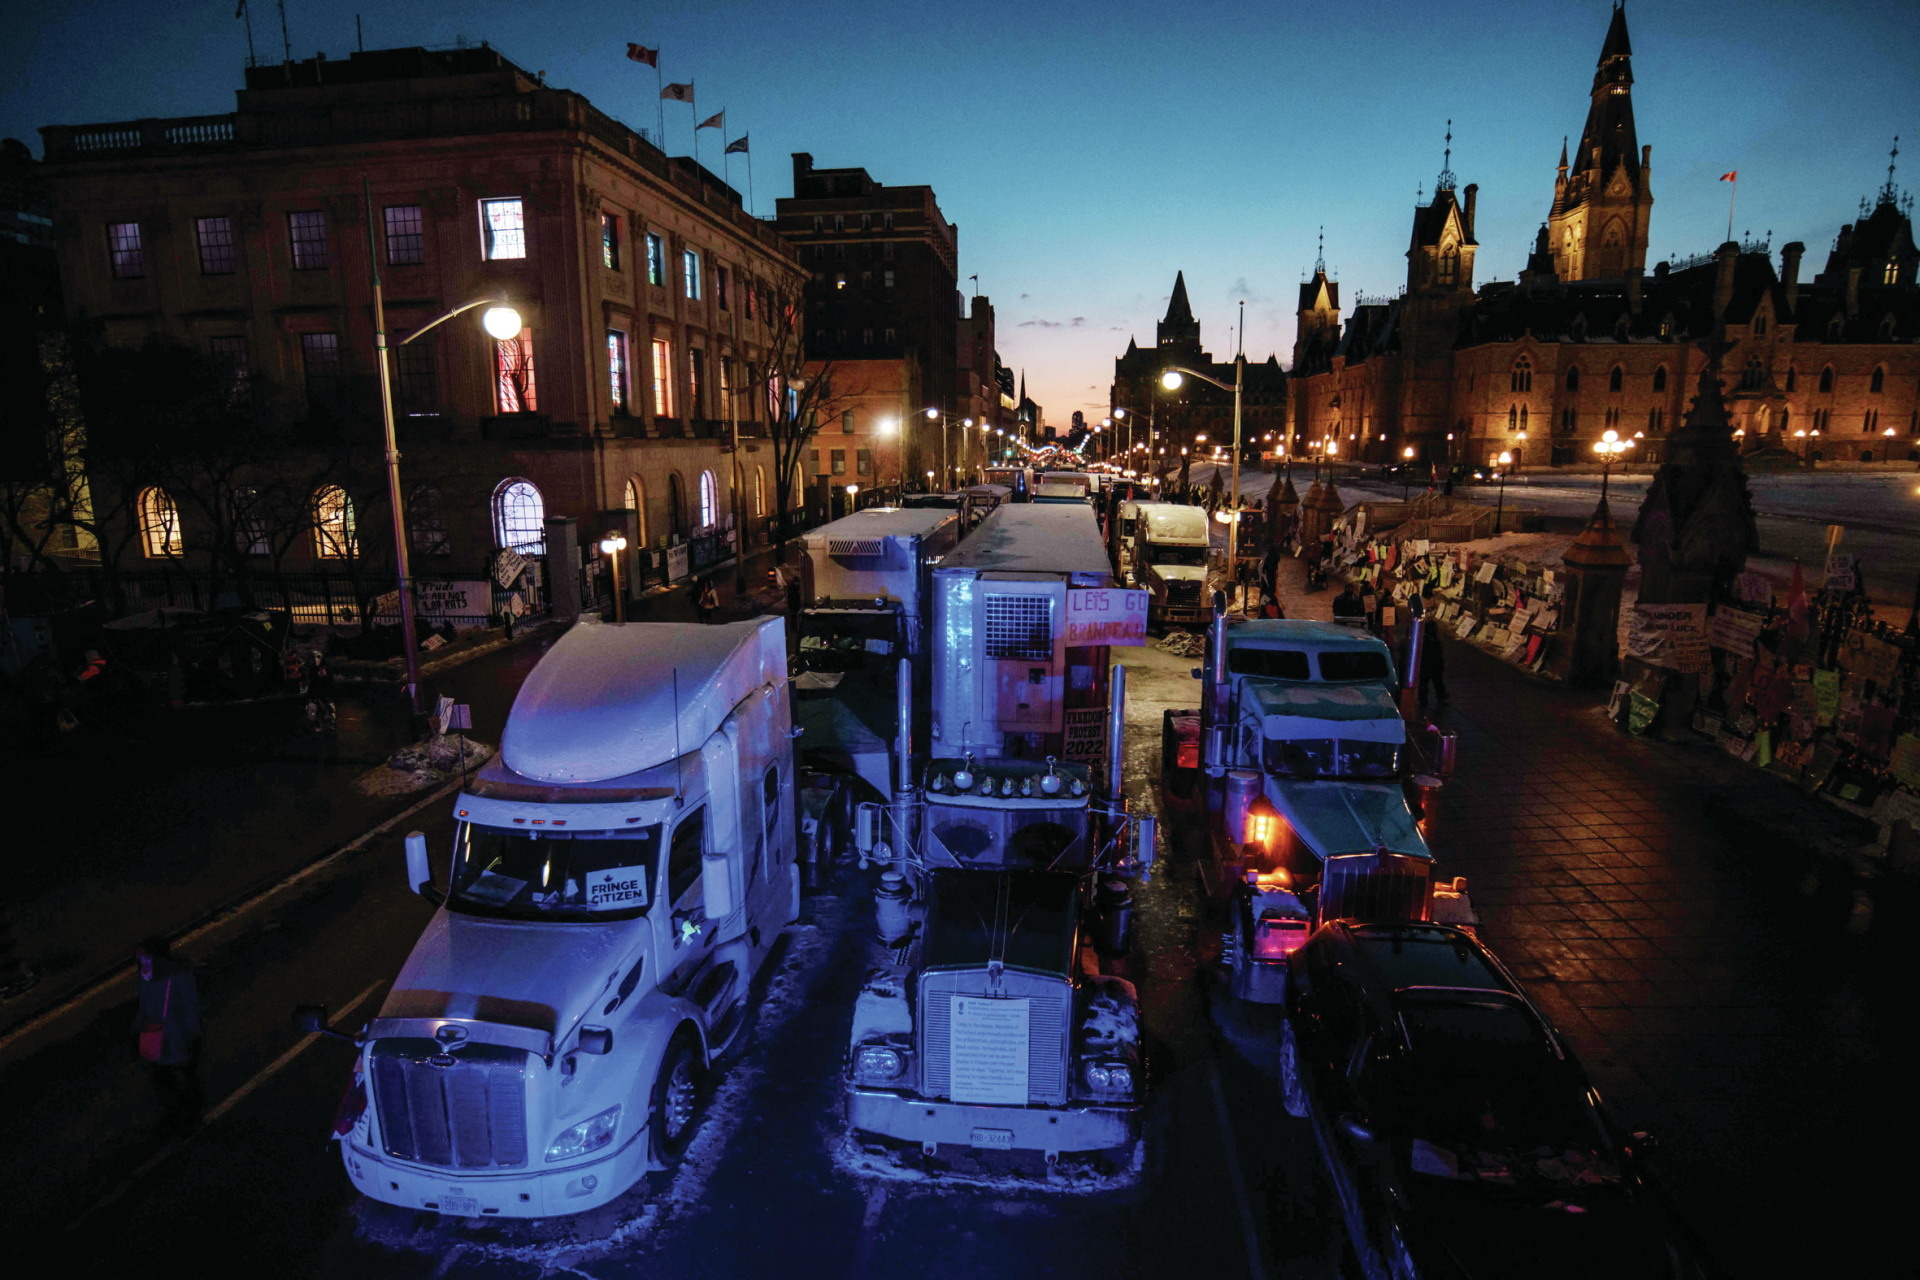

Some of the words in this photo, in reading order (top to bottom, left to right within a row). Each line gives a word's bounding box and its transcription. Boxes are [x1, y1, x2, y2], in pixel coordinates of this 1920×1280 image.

[448, 591, 467, 600] NOT
[1125, 593, 1147, 611] GO
[445, 599, 468, 610] RATS
[1066, 710, 1104, 724] FREEDOM
[1068, 725, 1101, 739] PROTEST
[1065, 740, 1104, 755] 2022
[592, 880, 638, 895] FRINGE
[591, 889, 643, 904] CITIZEN
